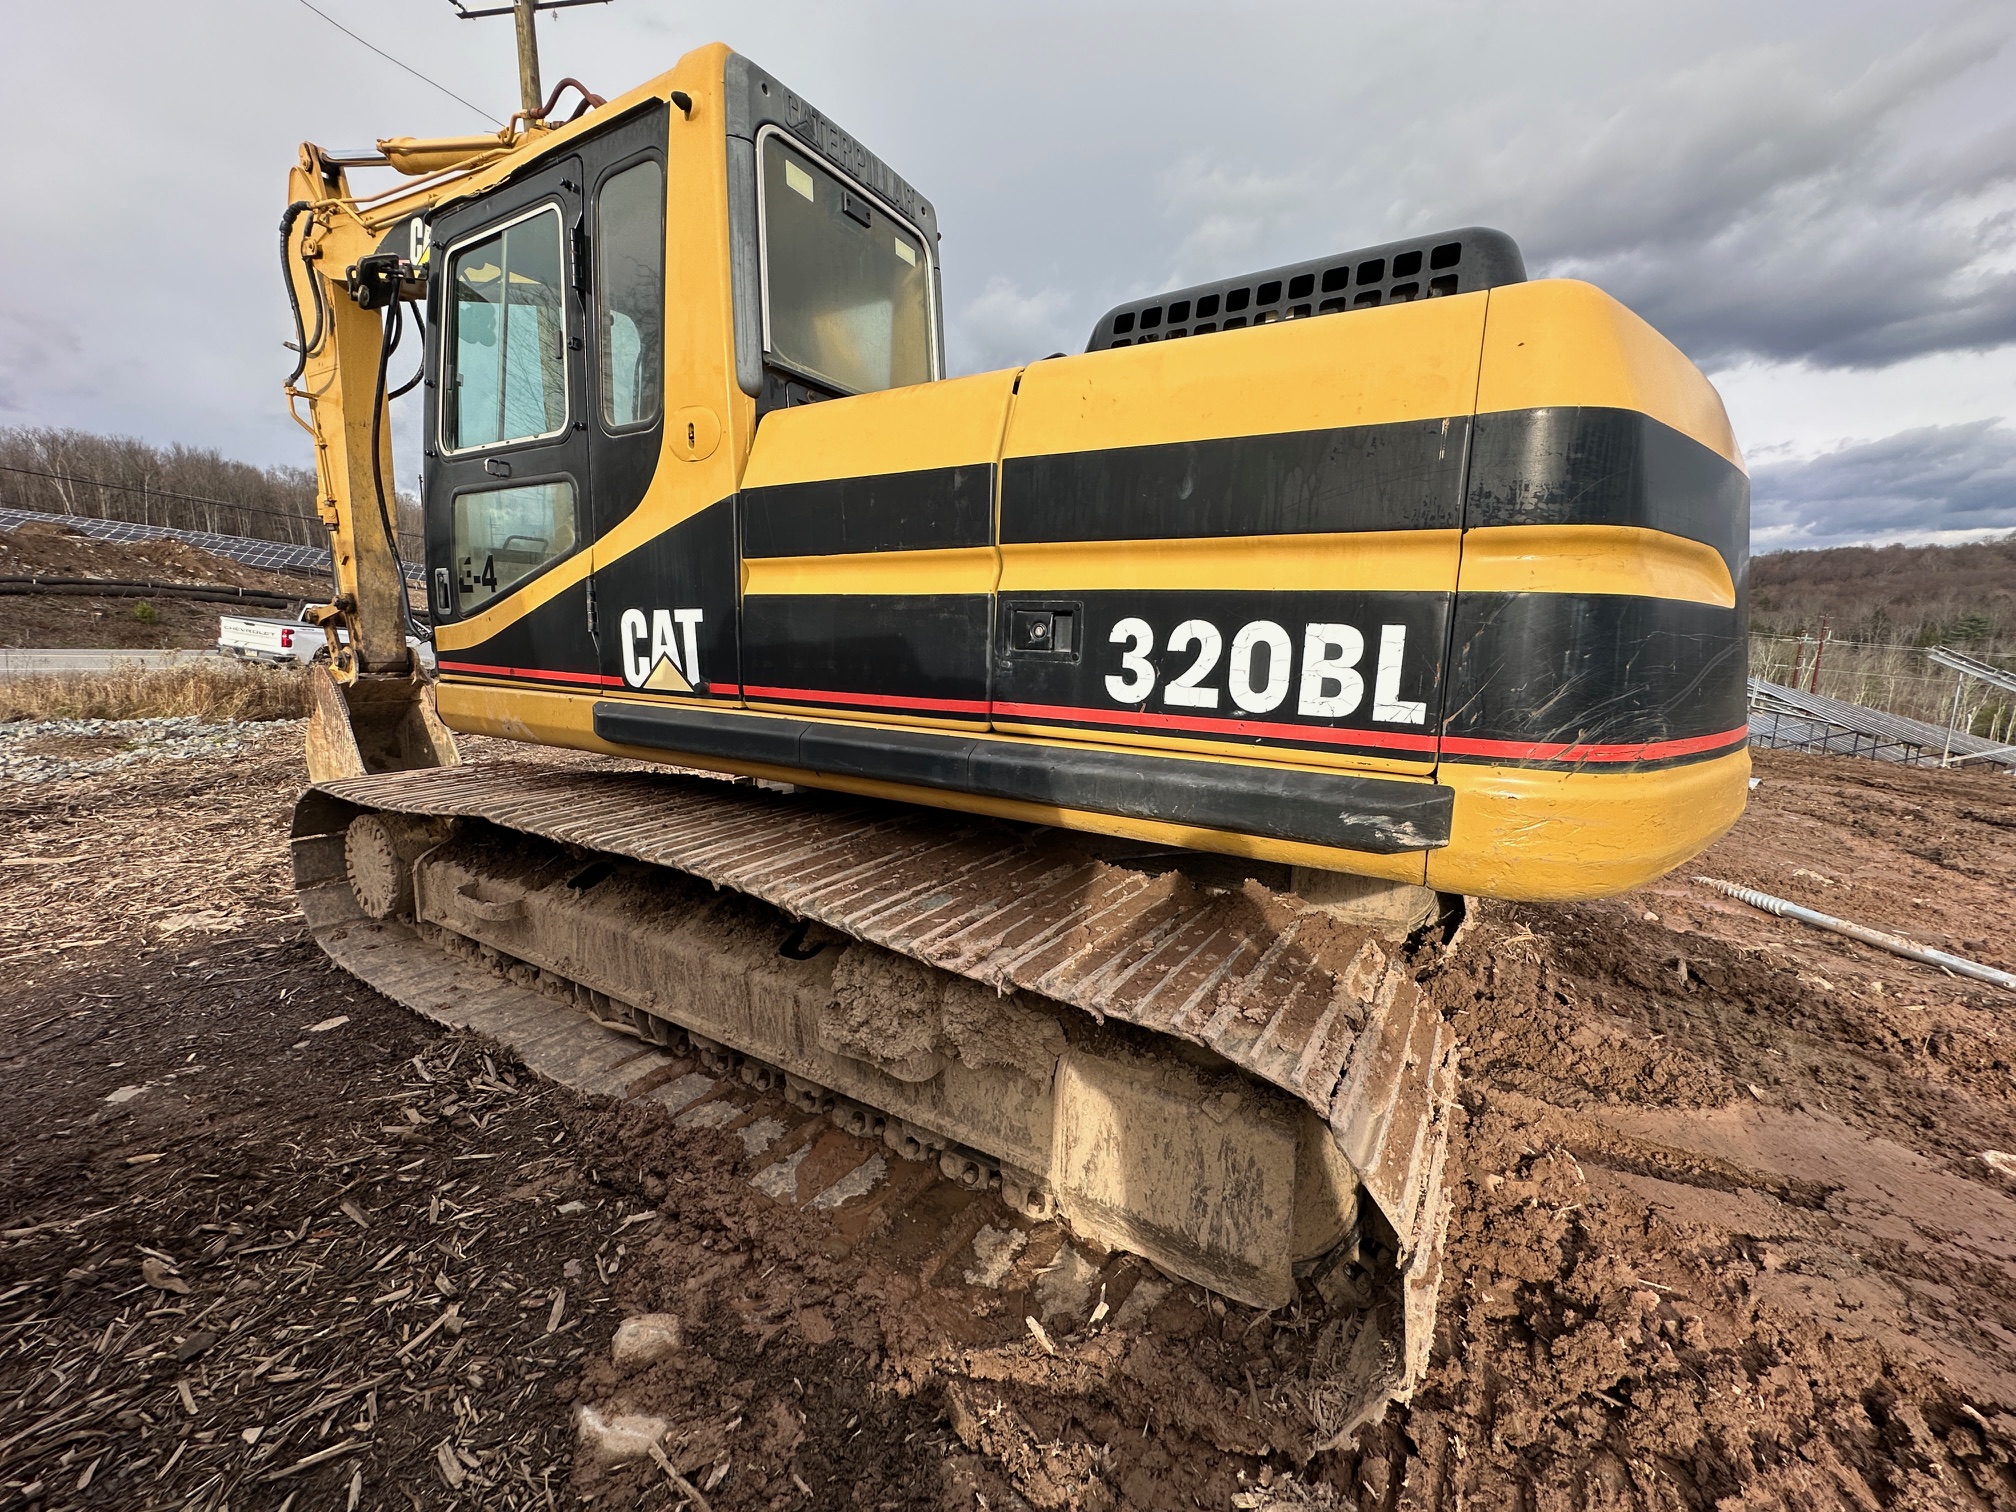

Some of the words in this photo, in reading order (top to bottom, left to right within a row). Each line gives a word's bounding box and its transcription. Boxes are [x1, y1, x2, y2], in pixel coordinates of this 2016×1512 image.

[783, 88, 917, 219] CATERPILLAR
[223, 625, 276, 637] CHEVROLET
[620, 608, 704, 688] CAT
[1104, 617, 1427, 725] 320BL
